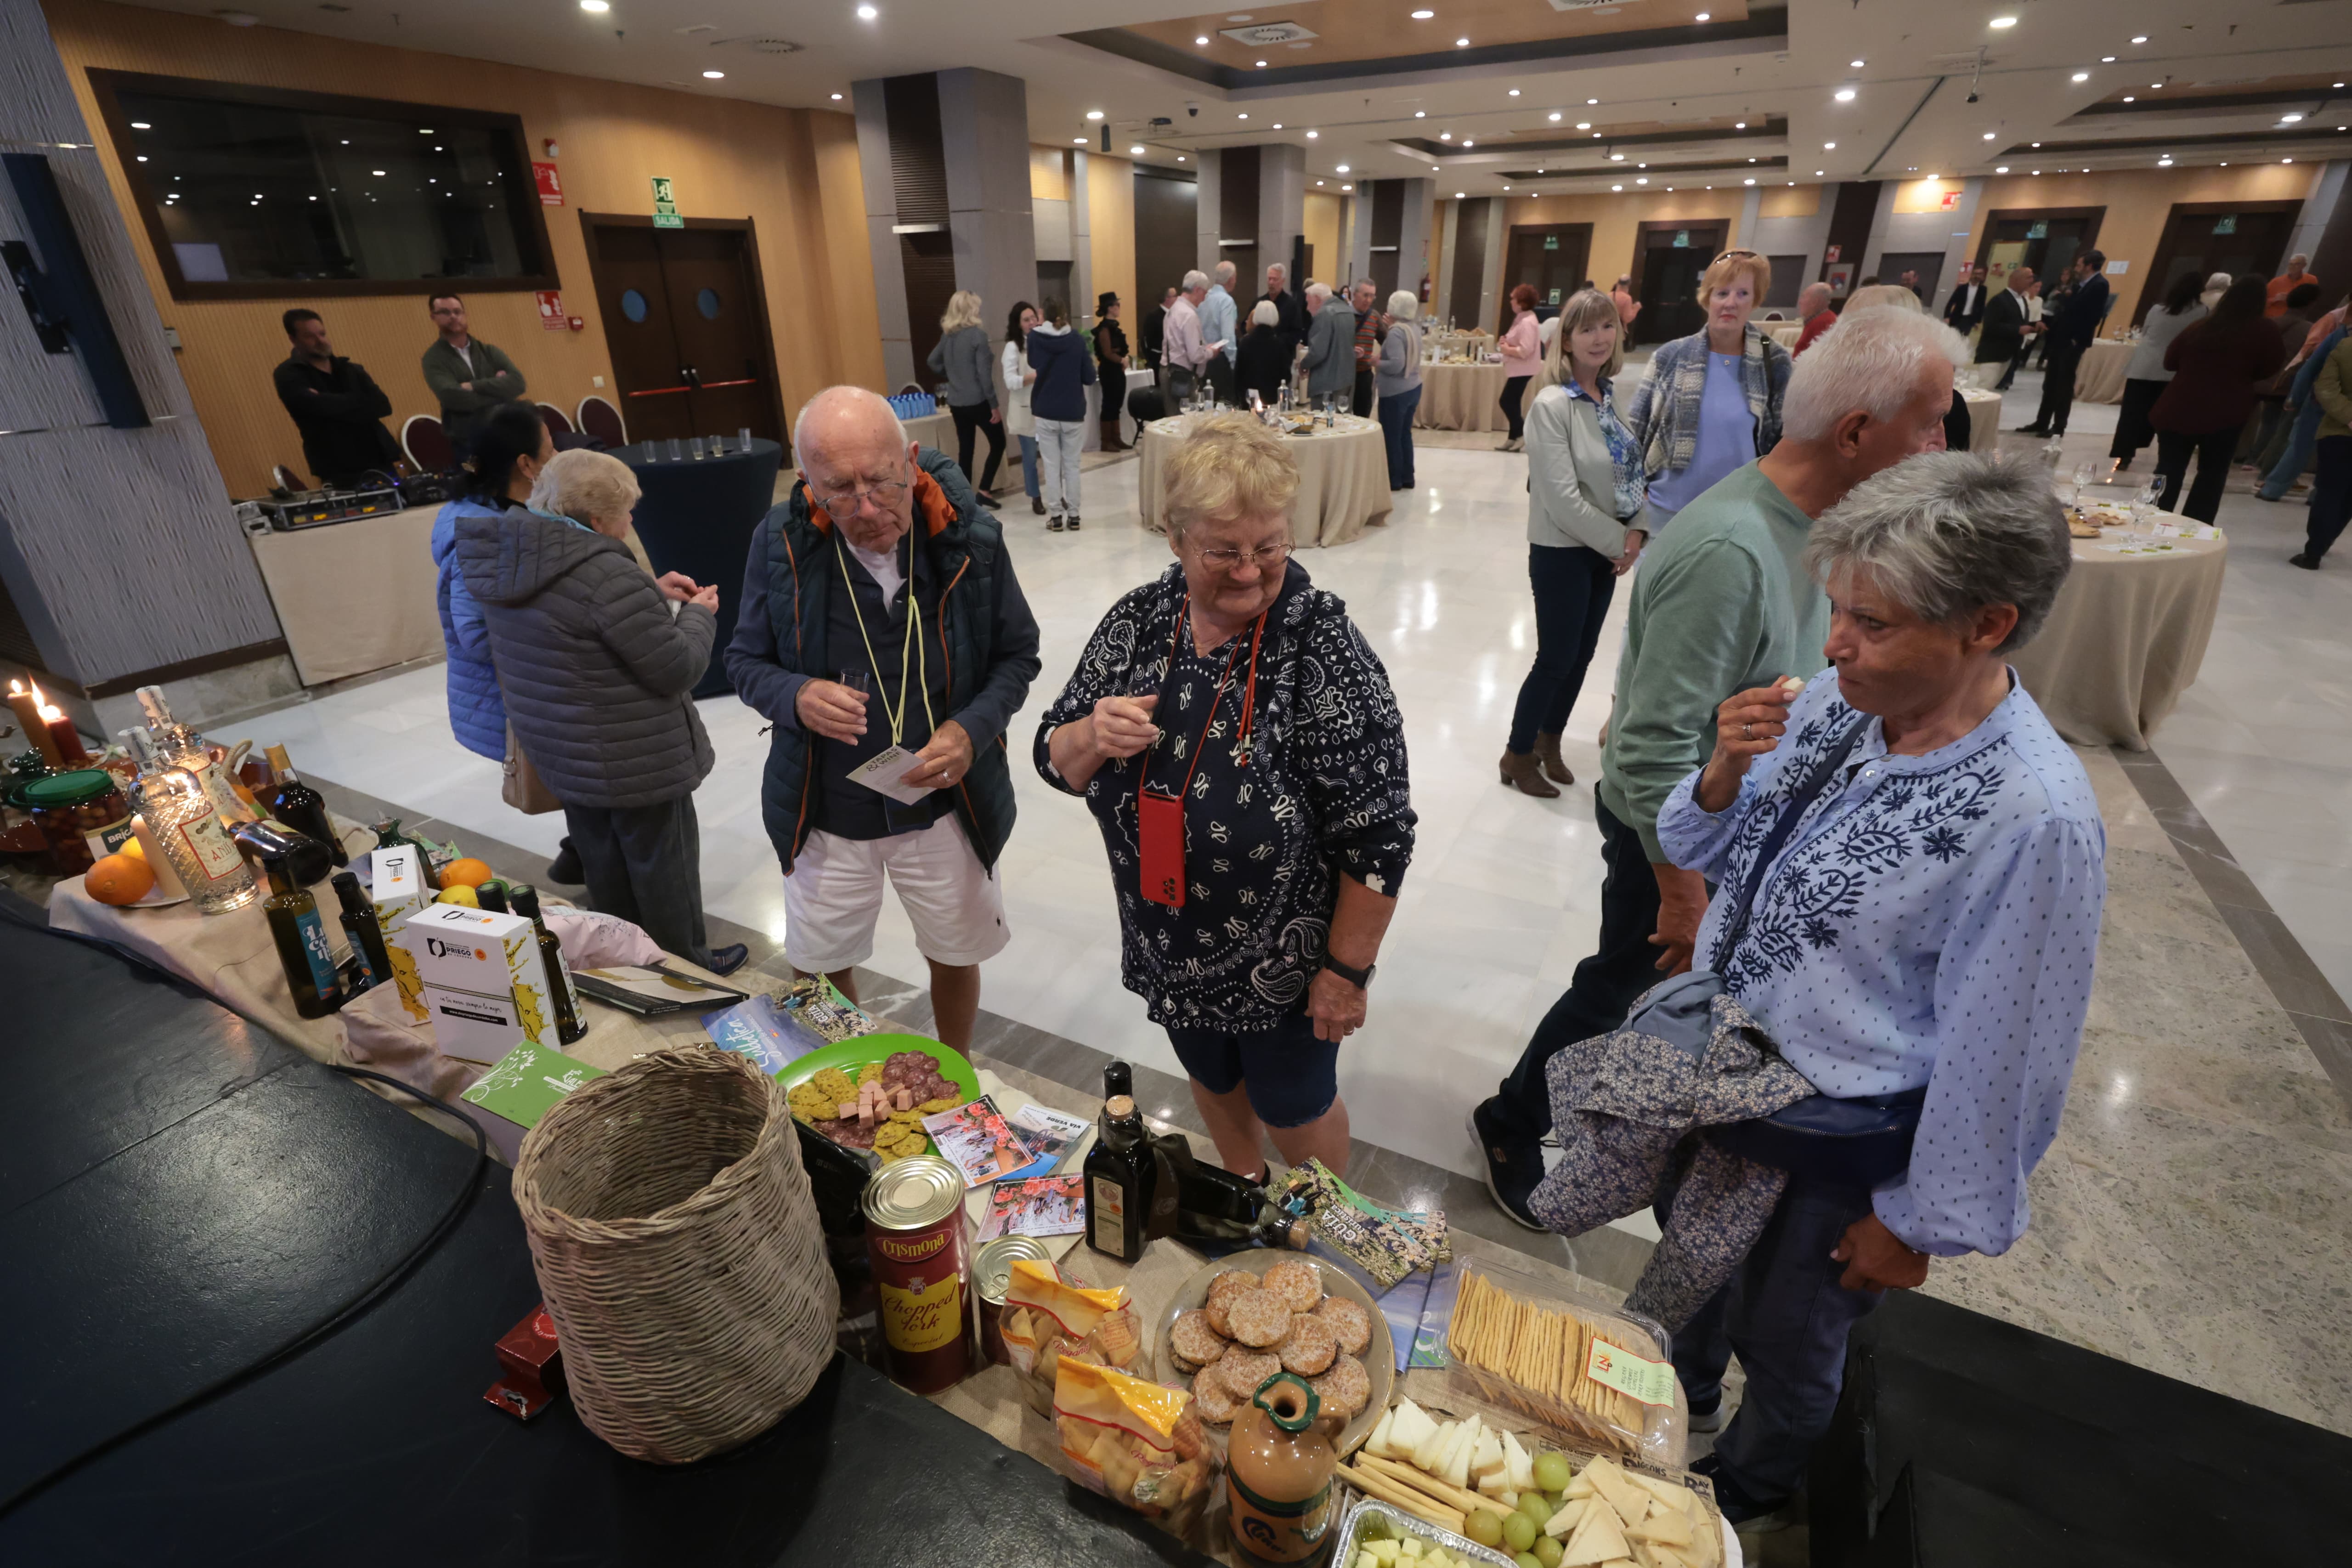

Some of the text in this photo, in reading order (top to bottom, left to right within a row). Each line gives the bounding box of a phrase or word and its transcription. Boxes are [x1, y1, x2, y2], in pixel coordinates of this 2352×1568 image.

[871, 748, 897, 764] TAPAS
[879, 751, 901, 764] WINE
[446, 946, 471, 956] PRIEGO
[1046, 1116, 1068, 1126] VERDE
[1322, 1209, 1357, 1240] GUÍA
[1331, 1204, 1365, 1234] turística
[882, 1234, 944, 1257] Crismona
[884, 1284, 956, 1322] Chopped
[901, 1313, 941, 1331] Pork
